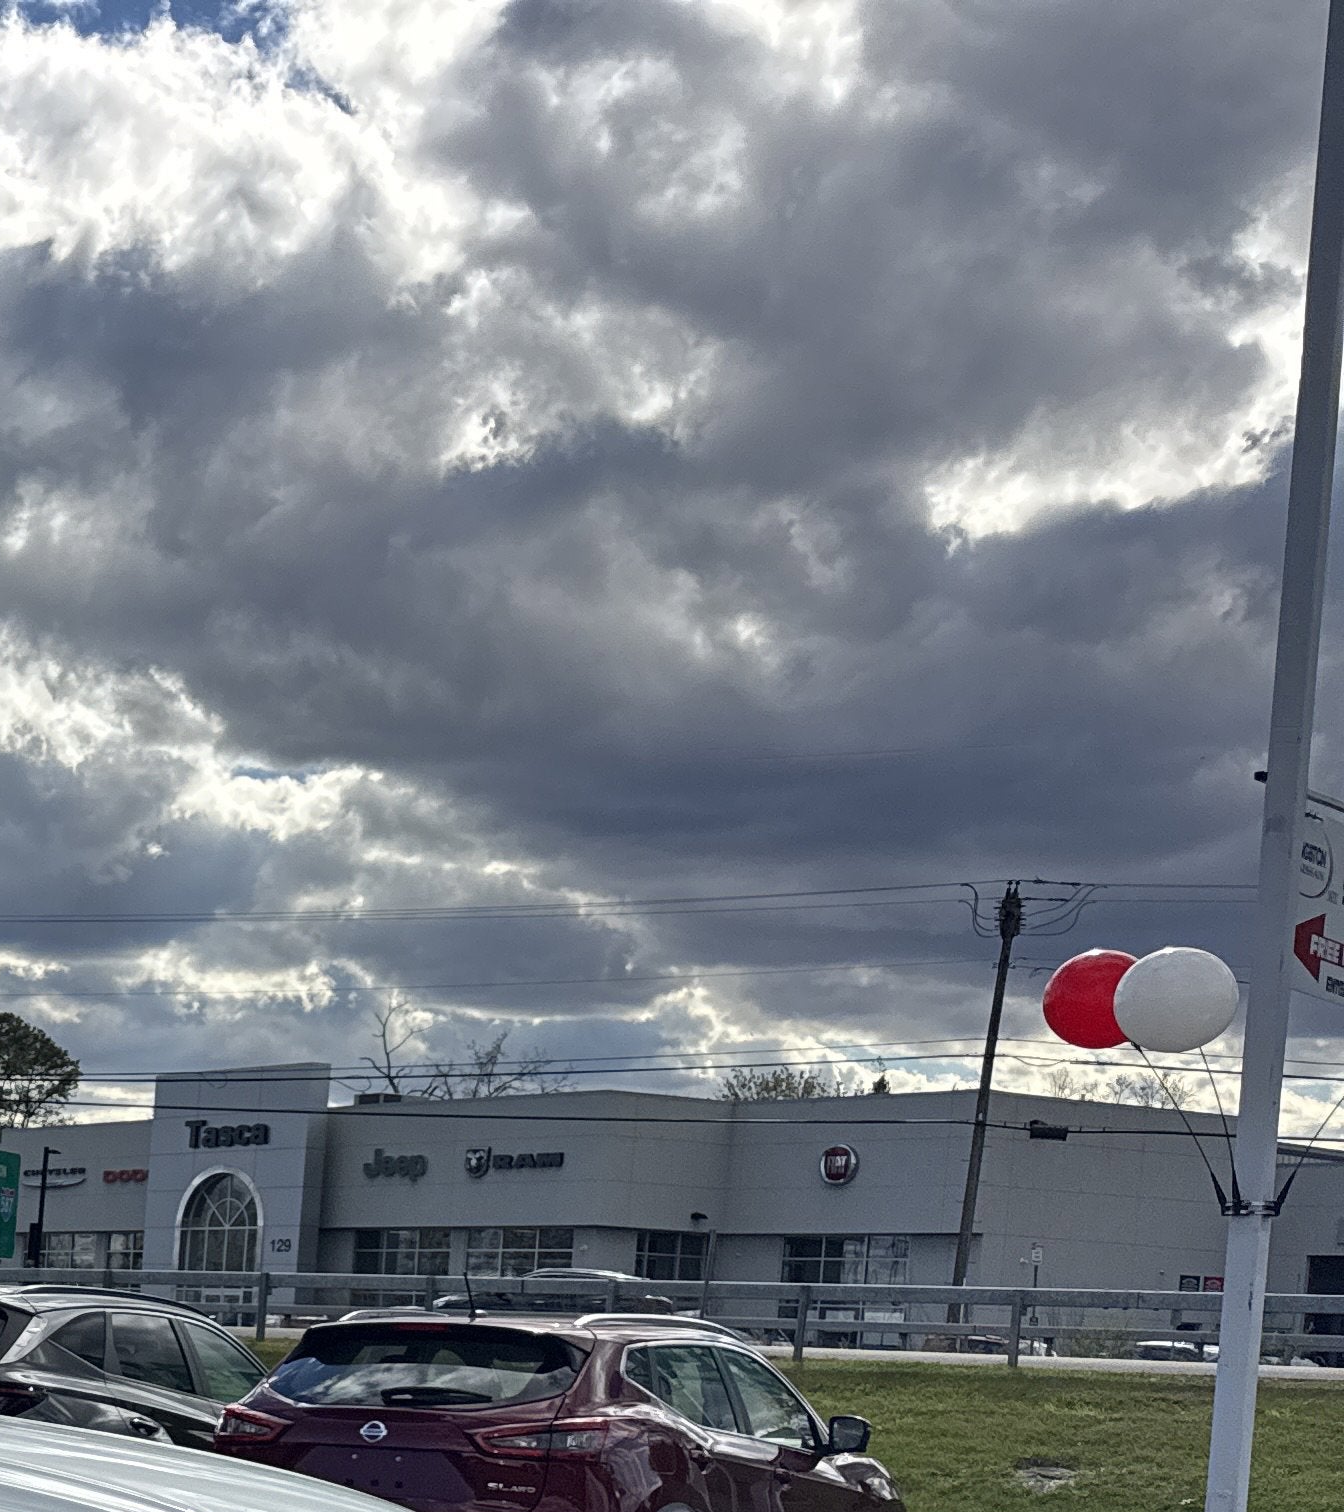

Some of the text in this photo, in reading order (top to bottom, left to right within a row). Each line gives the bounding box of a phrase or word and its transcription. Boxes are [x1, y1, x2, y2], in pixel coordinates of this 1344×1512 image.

[185, 1120, 270, 1149] Tasca
[363, 1149, 429, 1183] Jeep
[492, 1152, 565, 1170] RAM
[23, 1167, 86, 1177] CHYSLER
[270, 1239, 291, 1253] 129
